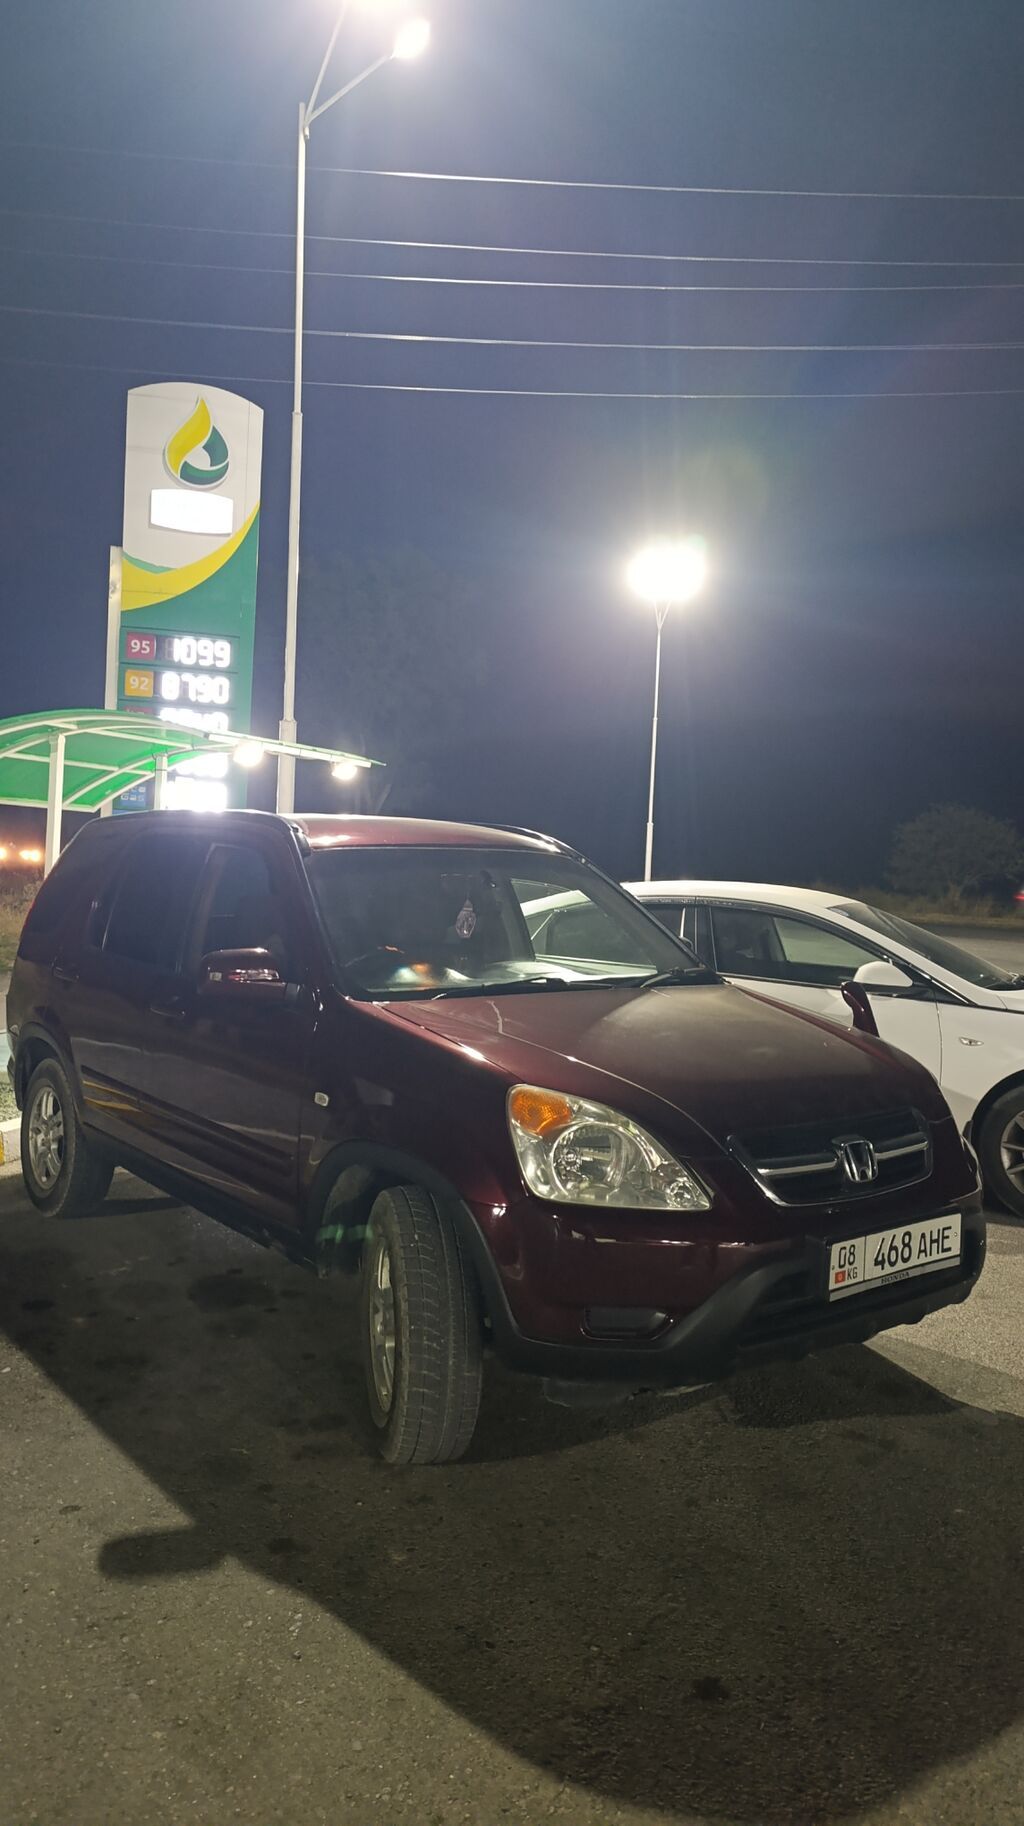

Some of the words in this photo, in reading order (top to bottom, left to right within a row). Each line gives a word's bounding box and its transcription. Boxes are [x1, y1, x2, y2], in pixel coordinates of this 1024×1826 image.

[130, 639, 151, 654] 95
[129, 675, 149, 691] 92
[838, 1244, 856, 1269] 08
[874, 1231, 912, 1271] 468
[917, 1226, 952, 1259] AHE
[847, 1267, 858, 1281] KG
[881, 1271, 910, 1285] HONDA
